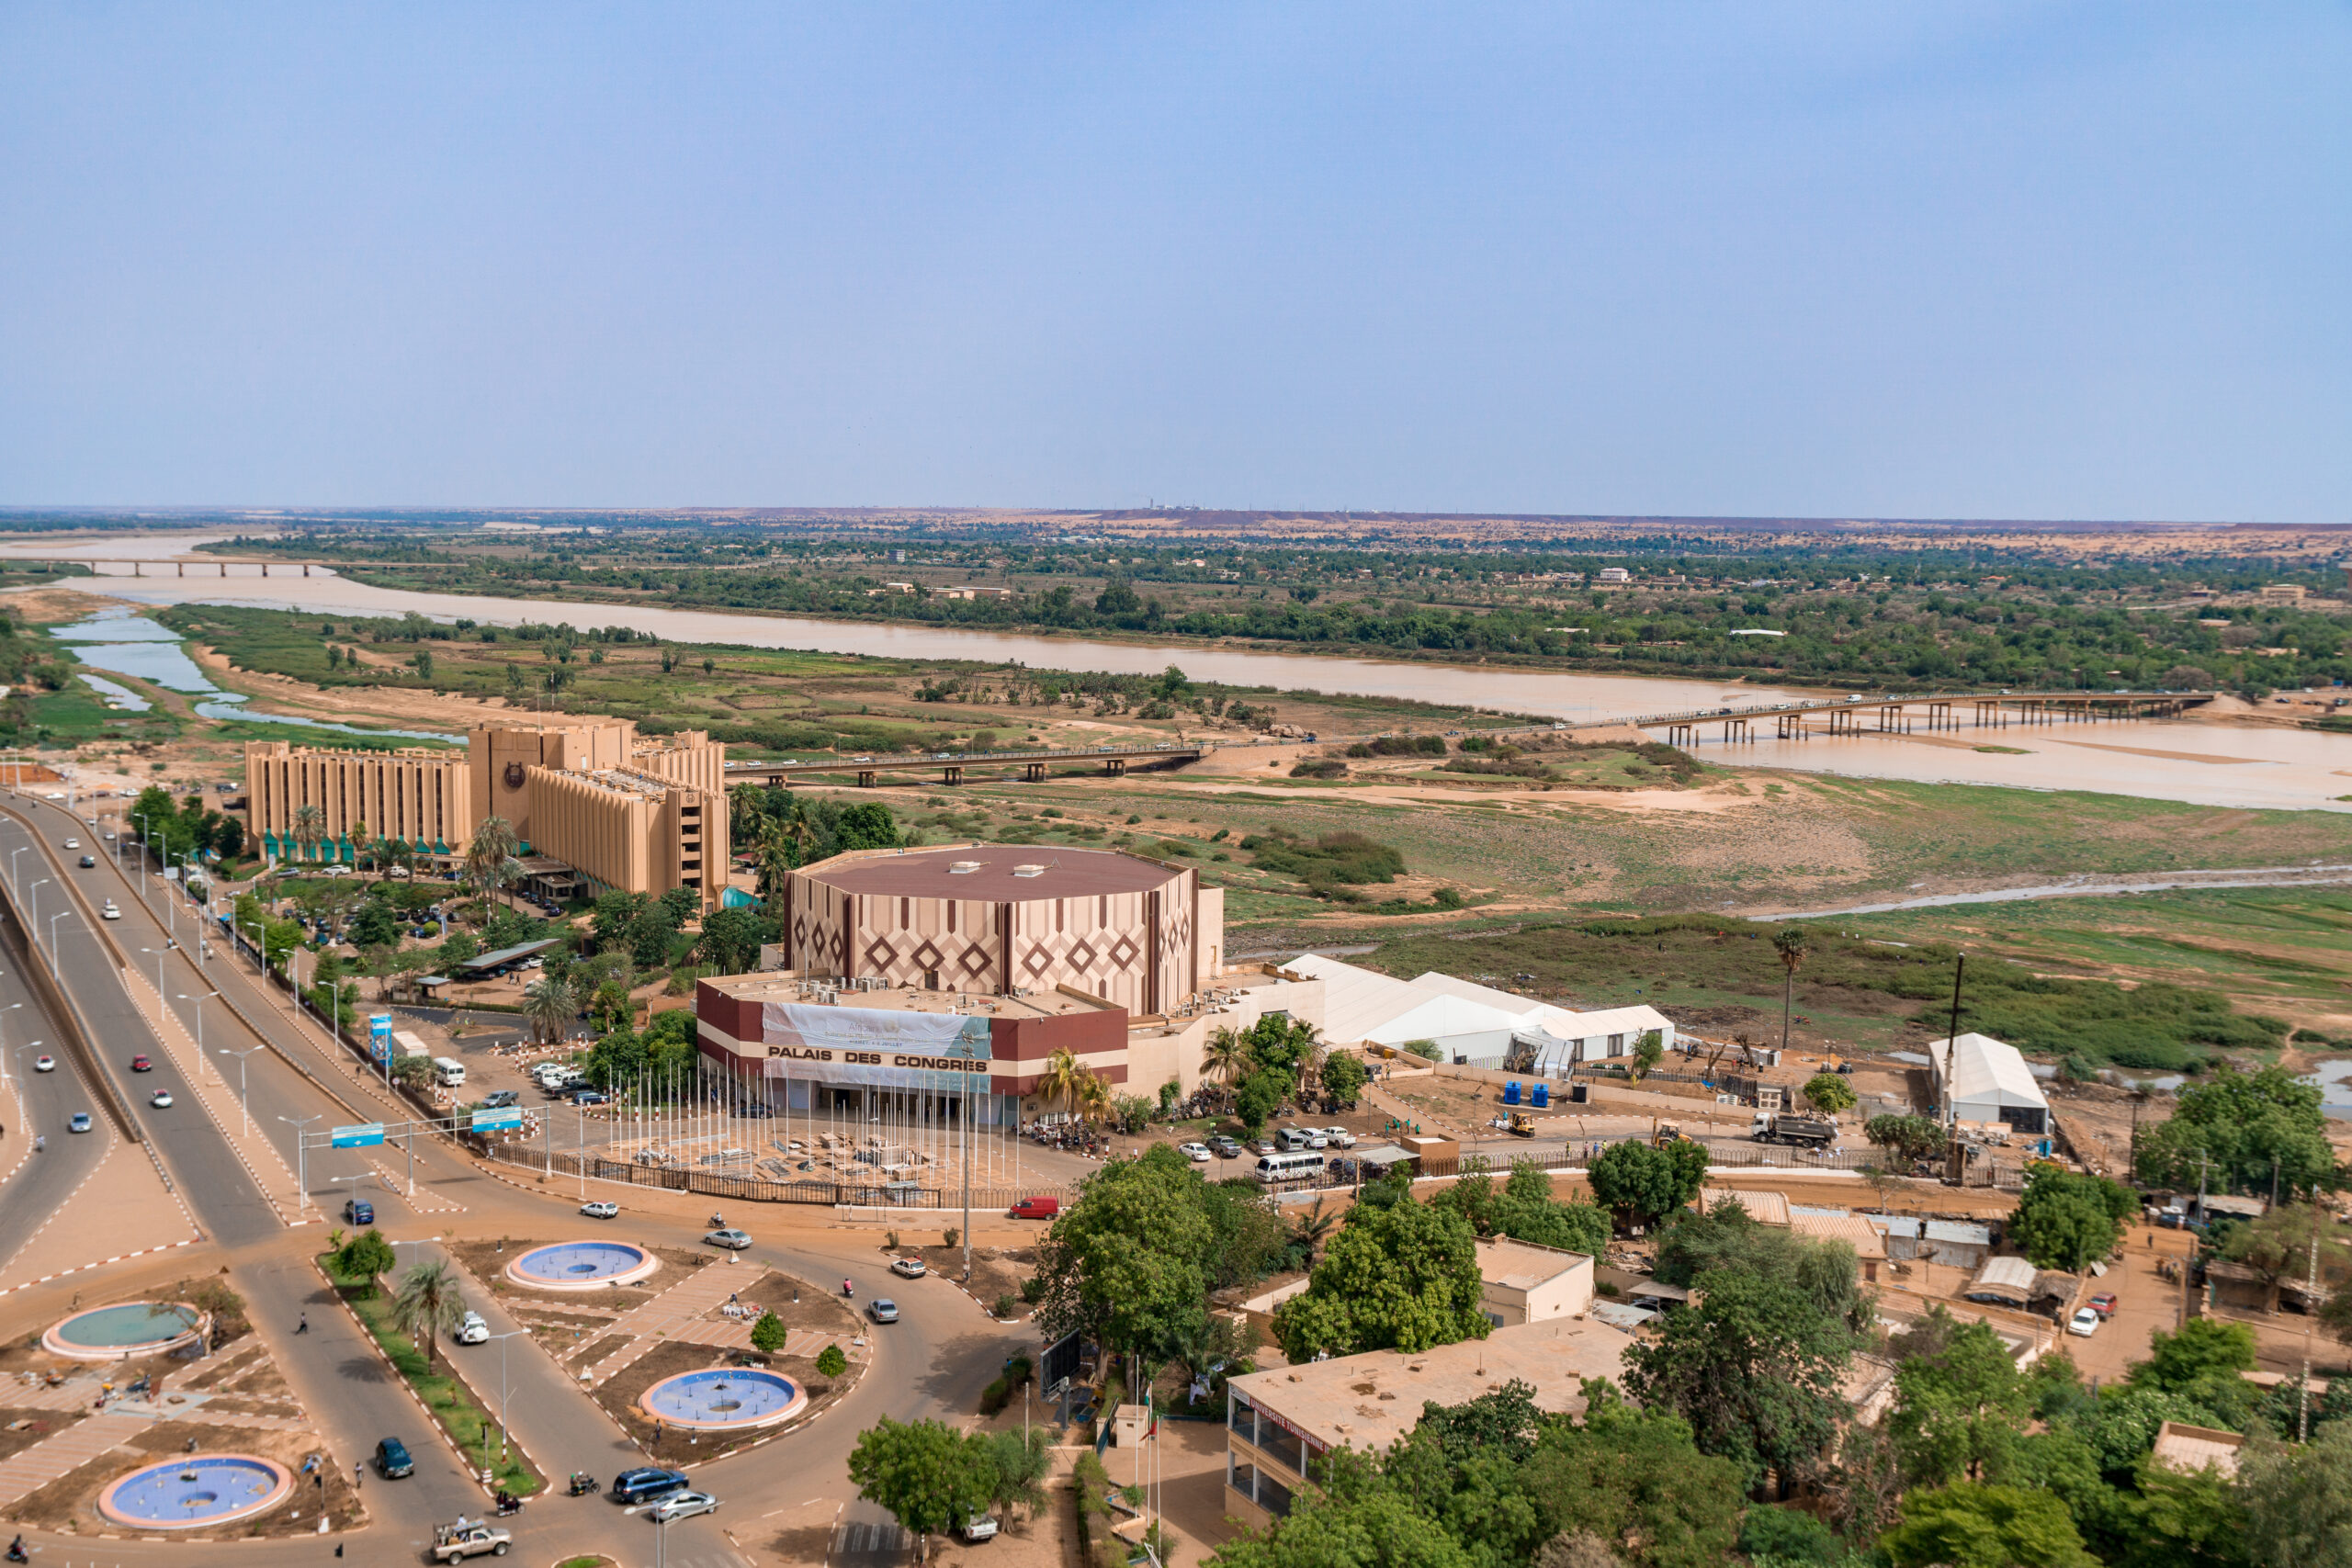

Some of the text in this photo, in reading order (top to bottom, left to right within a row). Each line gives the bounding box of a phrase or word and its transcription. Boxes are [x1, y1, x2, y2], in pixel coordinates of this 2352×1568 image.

[769, 1046, 988, 1072] PALAIS DES CONGRES
[1250, 1397, 1286, 1427] UNIVERSITE
[1286, 1420, 1324, 1451] TUNISIENNE
